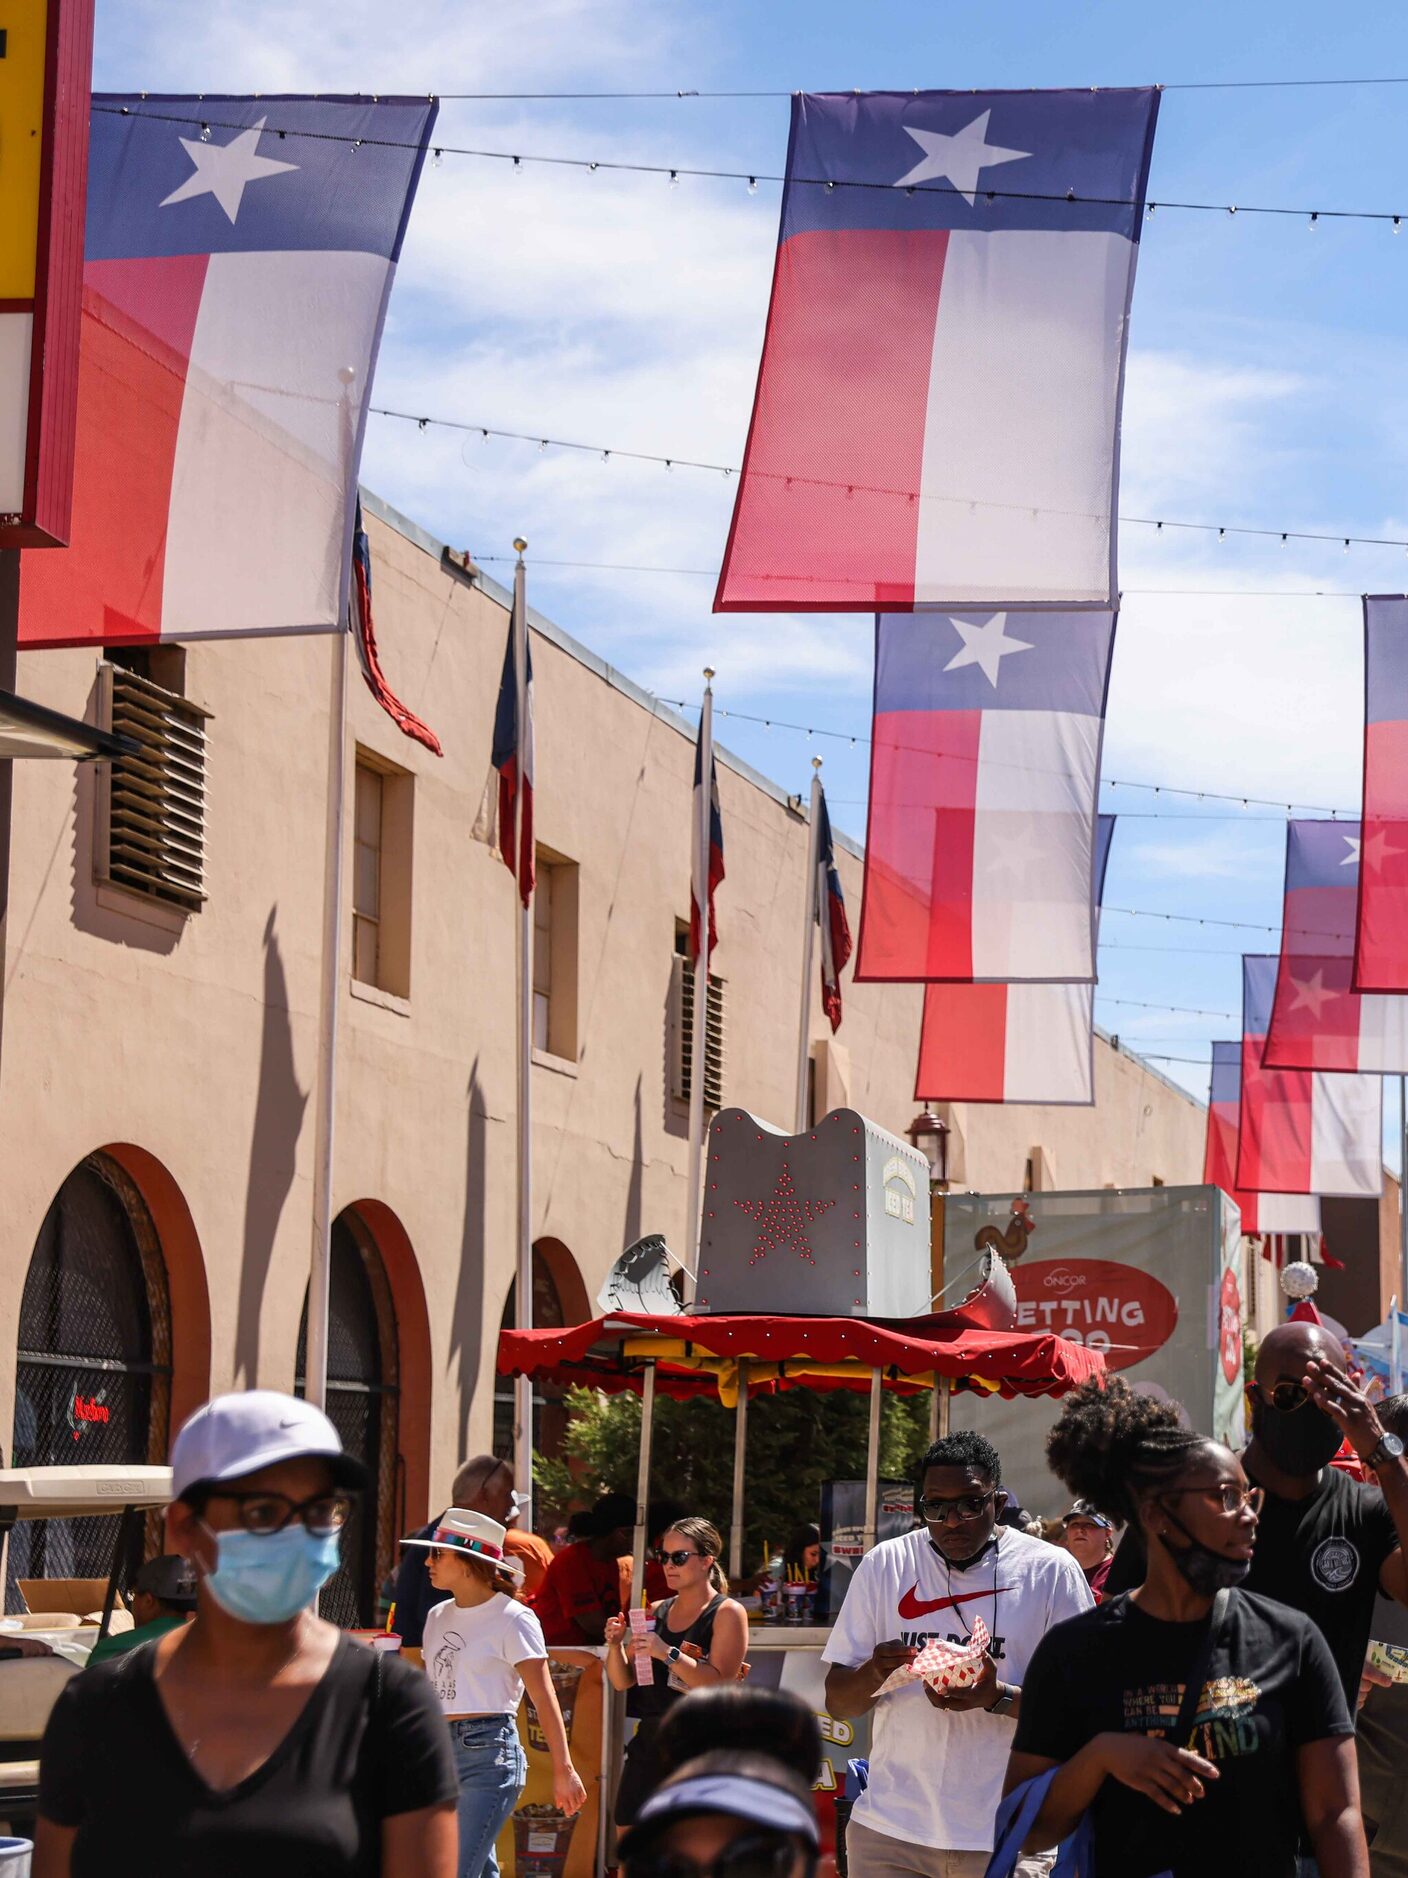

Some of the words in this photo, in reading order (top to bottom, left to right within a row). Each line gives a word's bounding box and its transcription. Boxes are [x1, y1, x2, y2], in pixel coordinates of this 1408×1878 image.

[1043, 1275, 1087, 1287] ONCOR
[1016, 1297, 1145, 1327] ETTING
[1029, 1328, 1111, 1355] OO
[833, 1545, 864, 1556] SWE
[901, 1632, 940, 1653] UST
[1122, 1694, 1156, 1707] WHERE
[1159, 1692, 1177, 1705] YOU
[815, 1712, 854, 1746] ED
